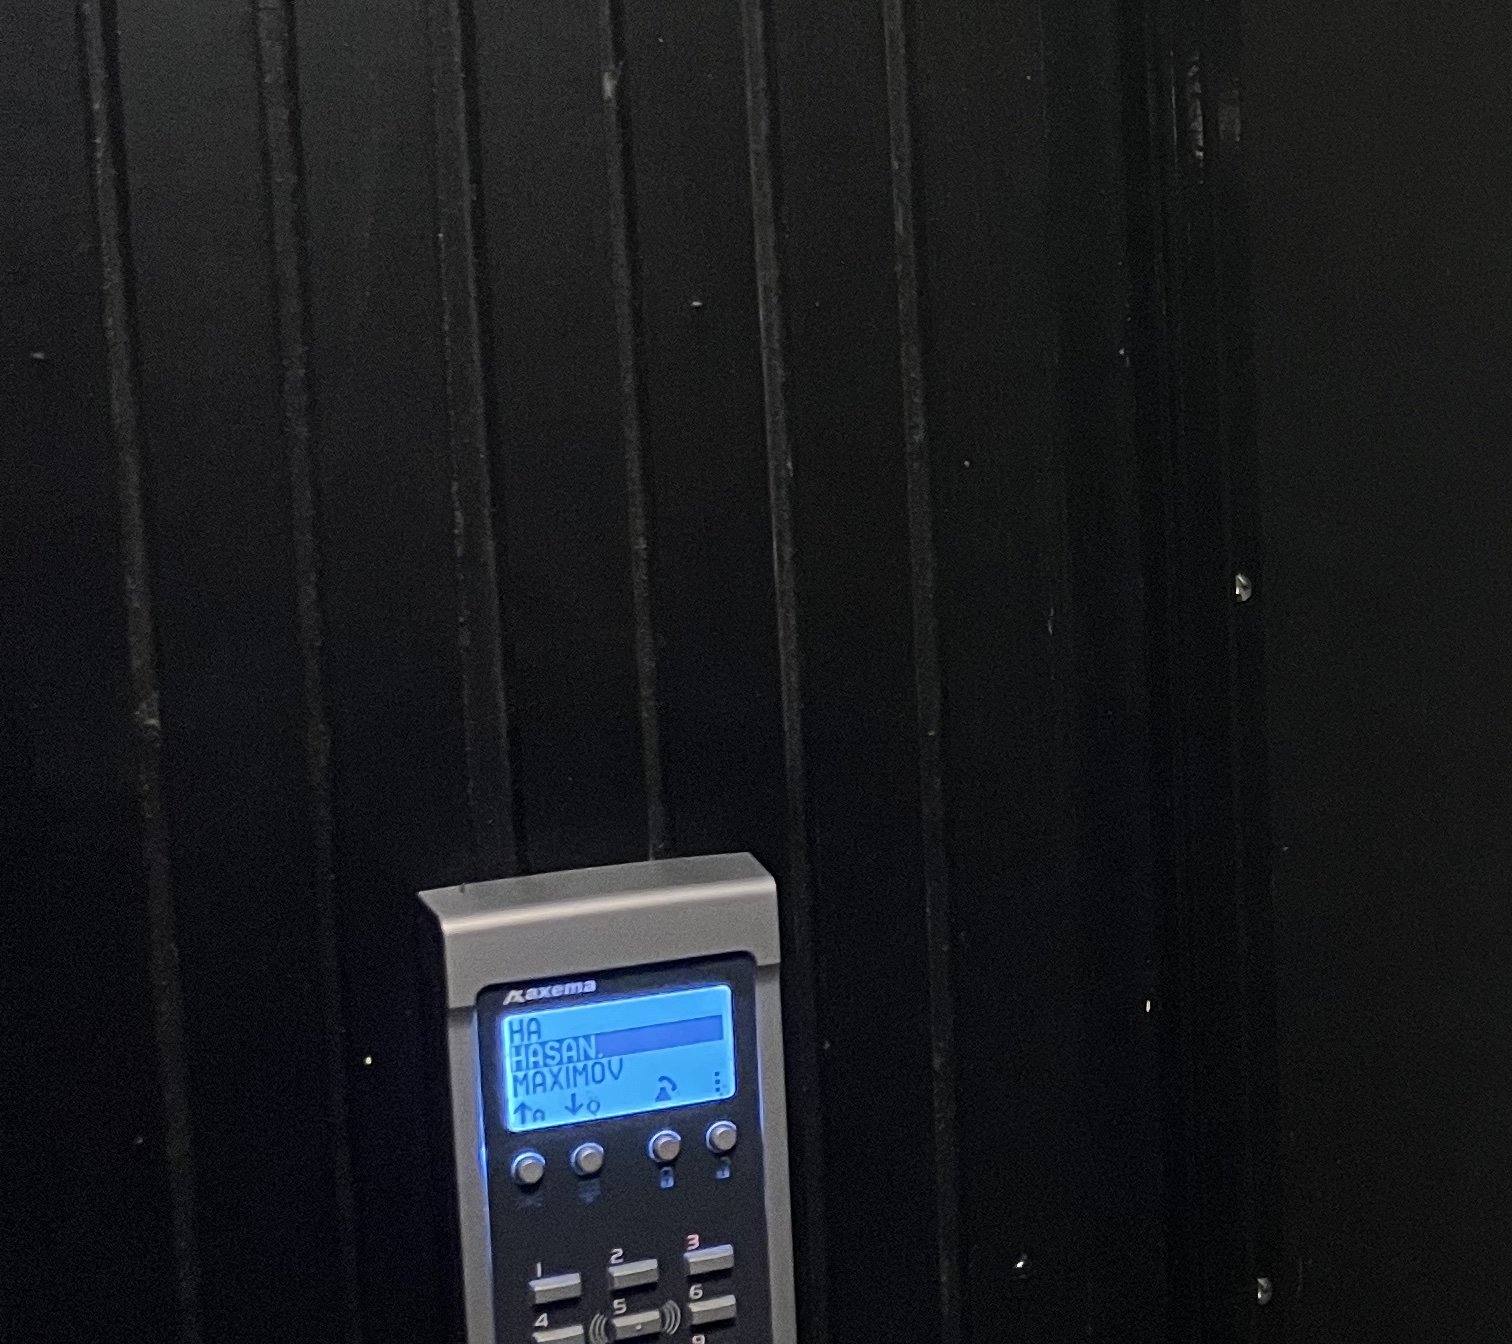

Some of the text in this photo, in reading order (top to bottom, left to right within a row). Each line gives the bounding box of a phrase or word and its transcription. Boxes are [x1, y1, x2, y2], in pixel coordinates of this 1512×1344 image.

[525, 979, 597, 1001] axema
[509, 1017, 541, 1045] HA
[512, 1057, 624, 1099] MAXIMOV
[536, 1234, 700, 1277] 1 2 3
[534, 1284, 703, 1328] 4 5 6
